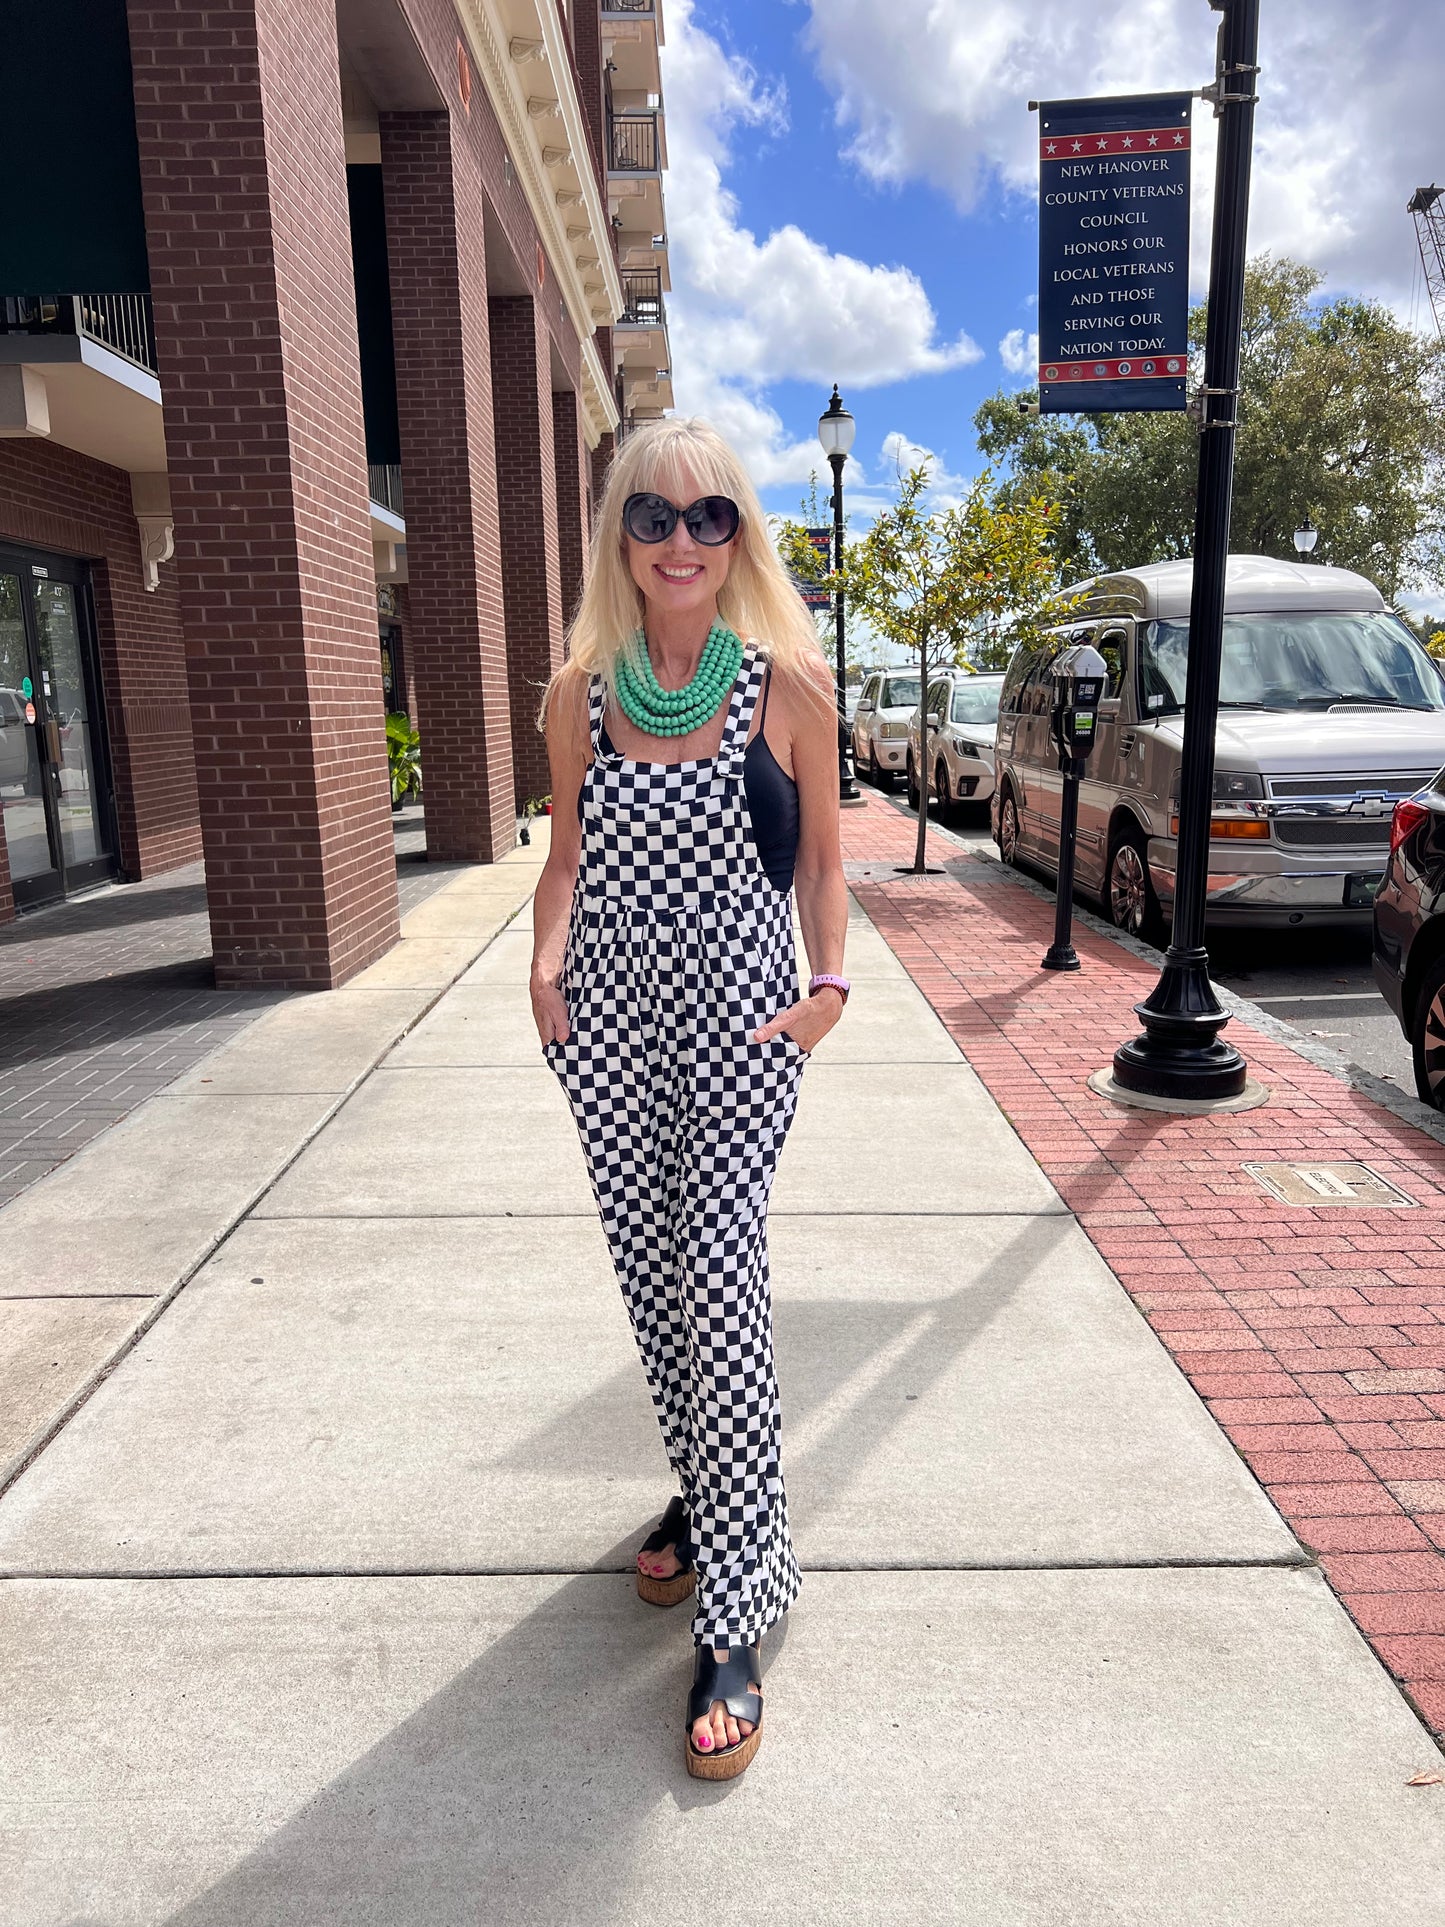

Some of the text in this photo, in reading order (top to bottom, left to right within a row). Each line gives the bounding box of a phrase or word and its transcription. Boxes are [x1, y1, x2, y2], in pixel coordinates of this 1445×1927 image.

[1061, 158, 1170, 178] NEW HANOVER
[1045, 183, 1184, 206] COUNTY VETERANS
[1080, 211, 1149, 229] COUNCIL
[1064, 236, 1166, 256] HONORS OUR
[1053, 261, 1175, 282] LOCAL VETERANS
[1070, 287, 1156, 306] AND THOSE
[1064, 312, 1163, 331] SERVING OUR
[1060, 337, 1167, 356] NATION TODAY.
[1309, 1172, 1342, 1195] ELECTRIC
